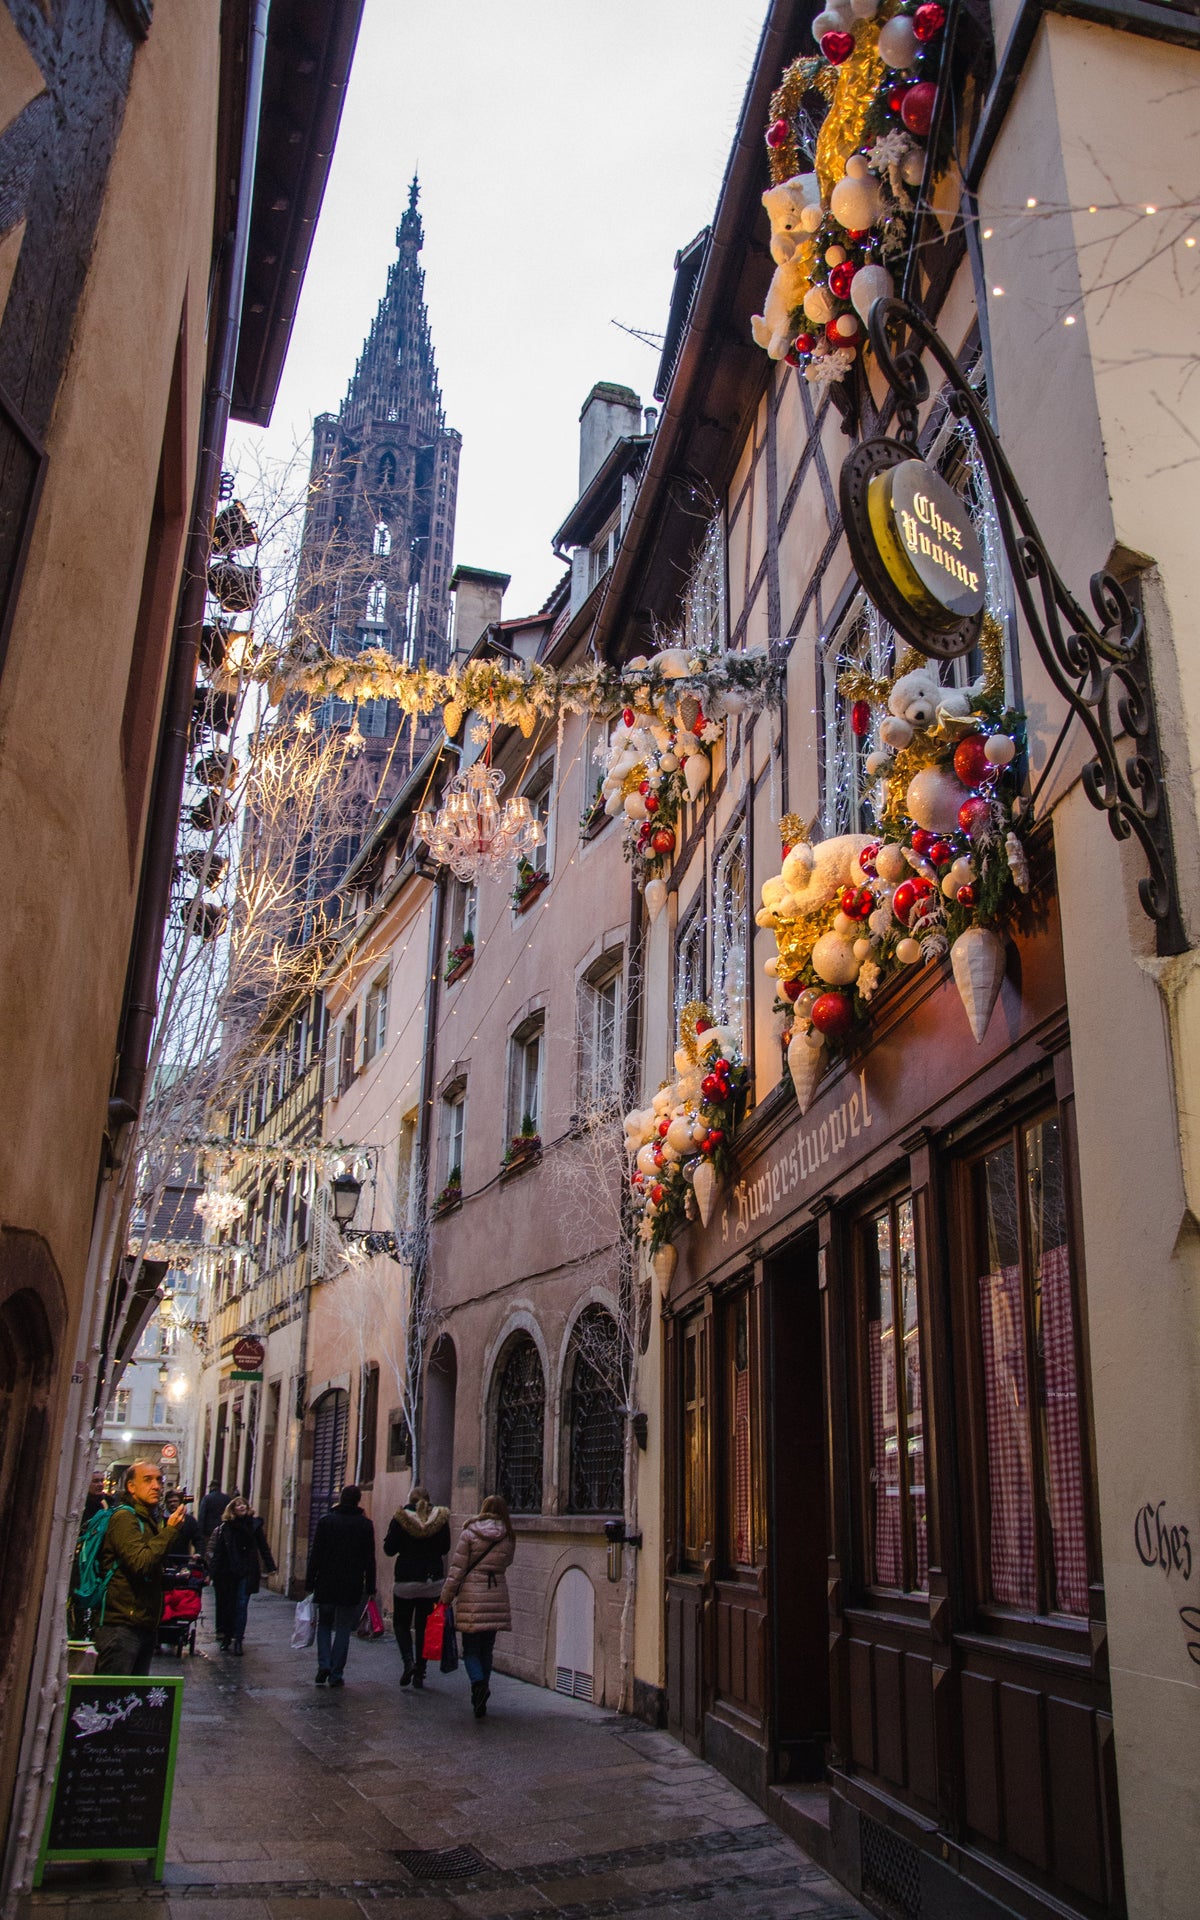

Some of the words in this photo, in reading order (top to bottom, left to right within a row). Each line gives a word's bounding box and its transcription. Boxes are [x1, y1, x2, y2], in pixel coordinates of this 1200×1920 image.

[901, 510, 980, 593] Yvonne
[913, 492, 963, 550] Chez
[733, 1067, 873, 1243] Burjerstuewel
[1134, 1500, 1192, 1581] Chez
